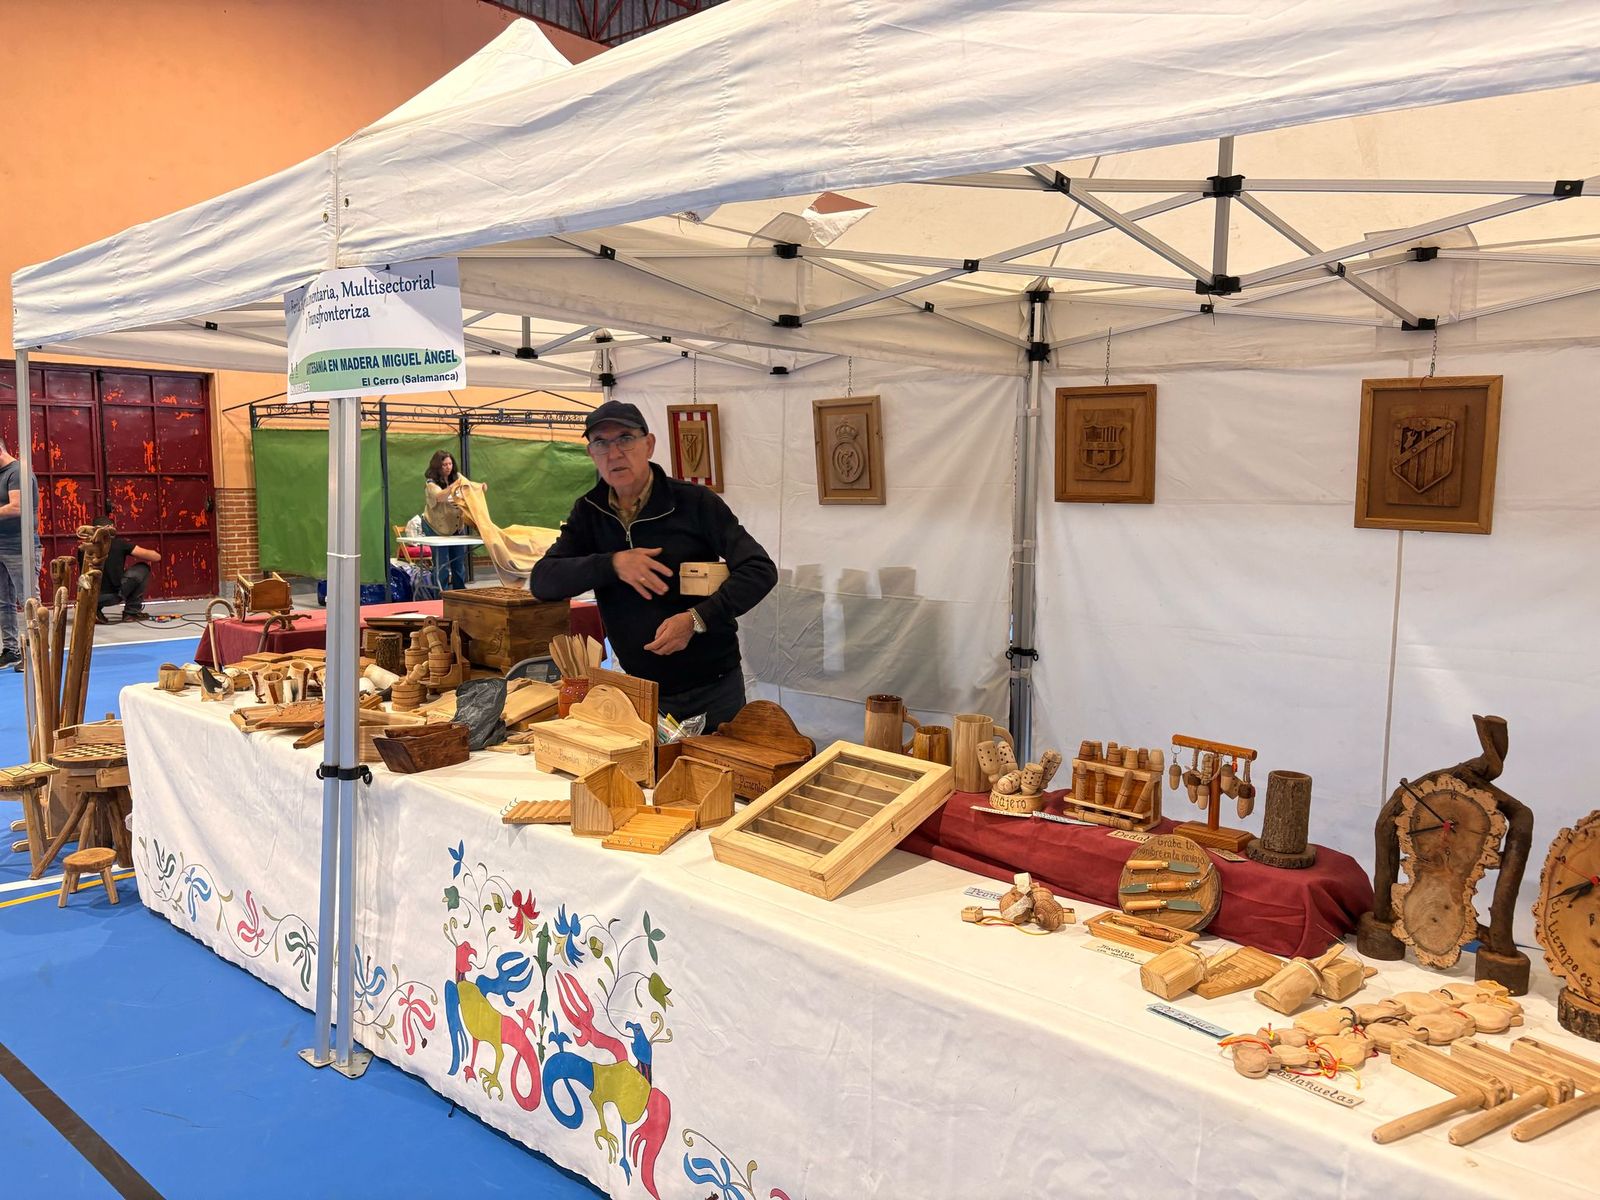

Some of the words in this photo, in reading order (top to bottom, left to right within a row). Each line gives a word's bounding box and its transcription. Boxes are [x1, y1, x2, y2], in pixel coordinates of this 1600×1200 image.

[341, 270, 436, 297] Multisectorial
[328, 360, 339, 373] EN
[340, 355, 380, 371] MADERA
[382, 353, 422, 367] MIGUEL
[424, 348, 458, 365] ÁNGEL
[362, 377, 370, 387] El
[373, 377, 399, 386] Cerro
[402, 371, 459, 386] (Salamanca)
